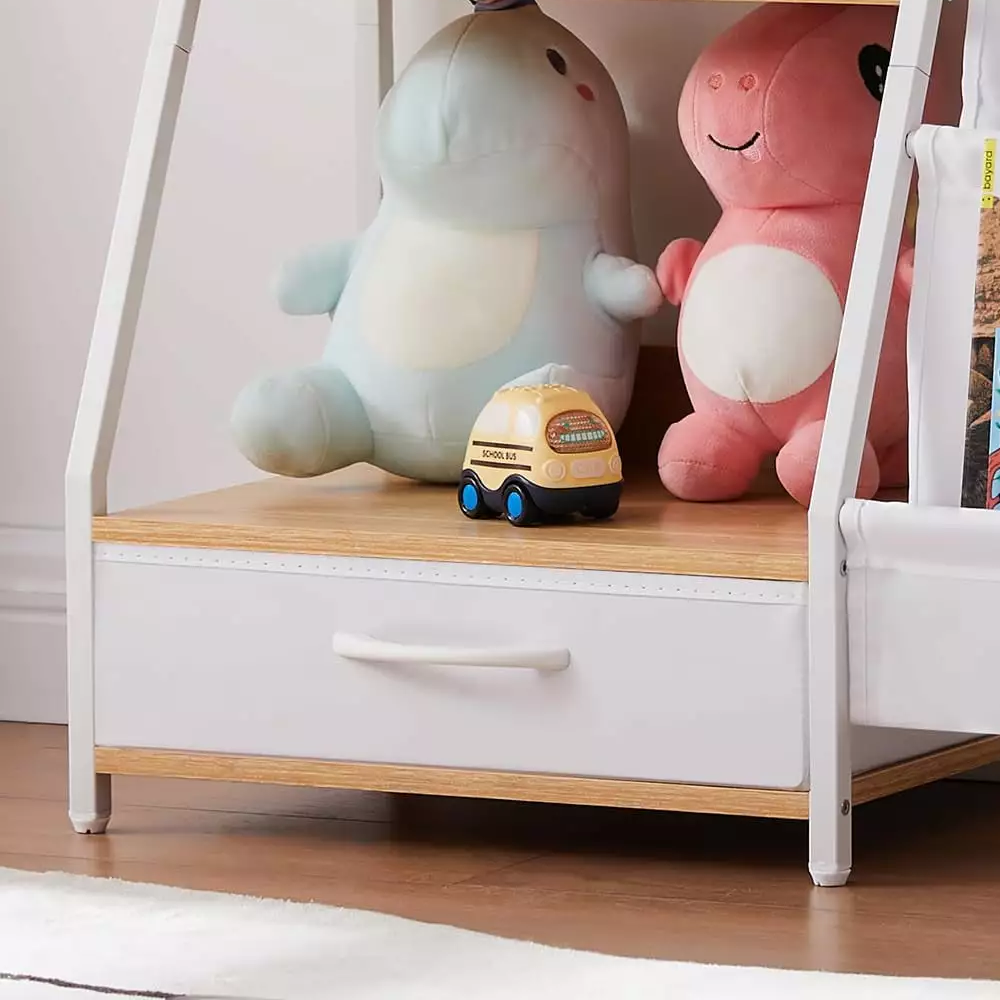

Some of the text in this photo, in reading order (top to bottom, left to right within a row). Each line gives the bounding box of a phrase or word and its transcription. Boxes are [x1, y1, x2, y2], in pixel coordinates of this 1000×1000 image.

[983, 150, 993, 190] bayard
[482, 449, 516, 461] SCHOOL BUS
